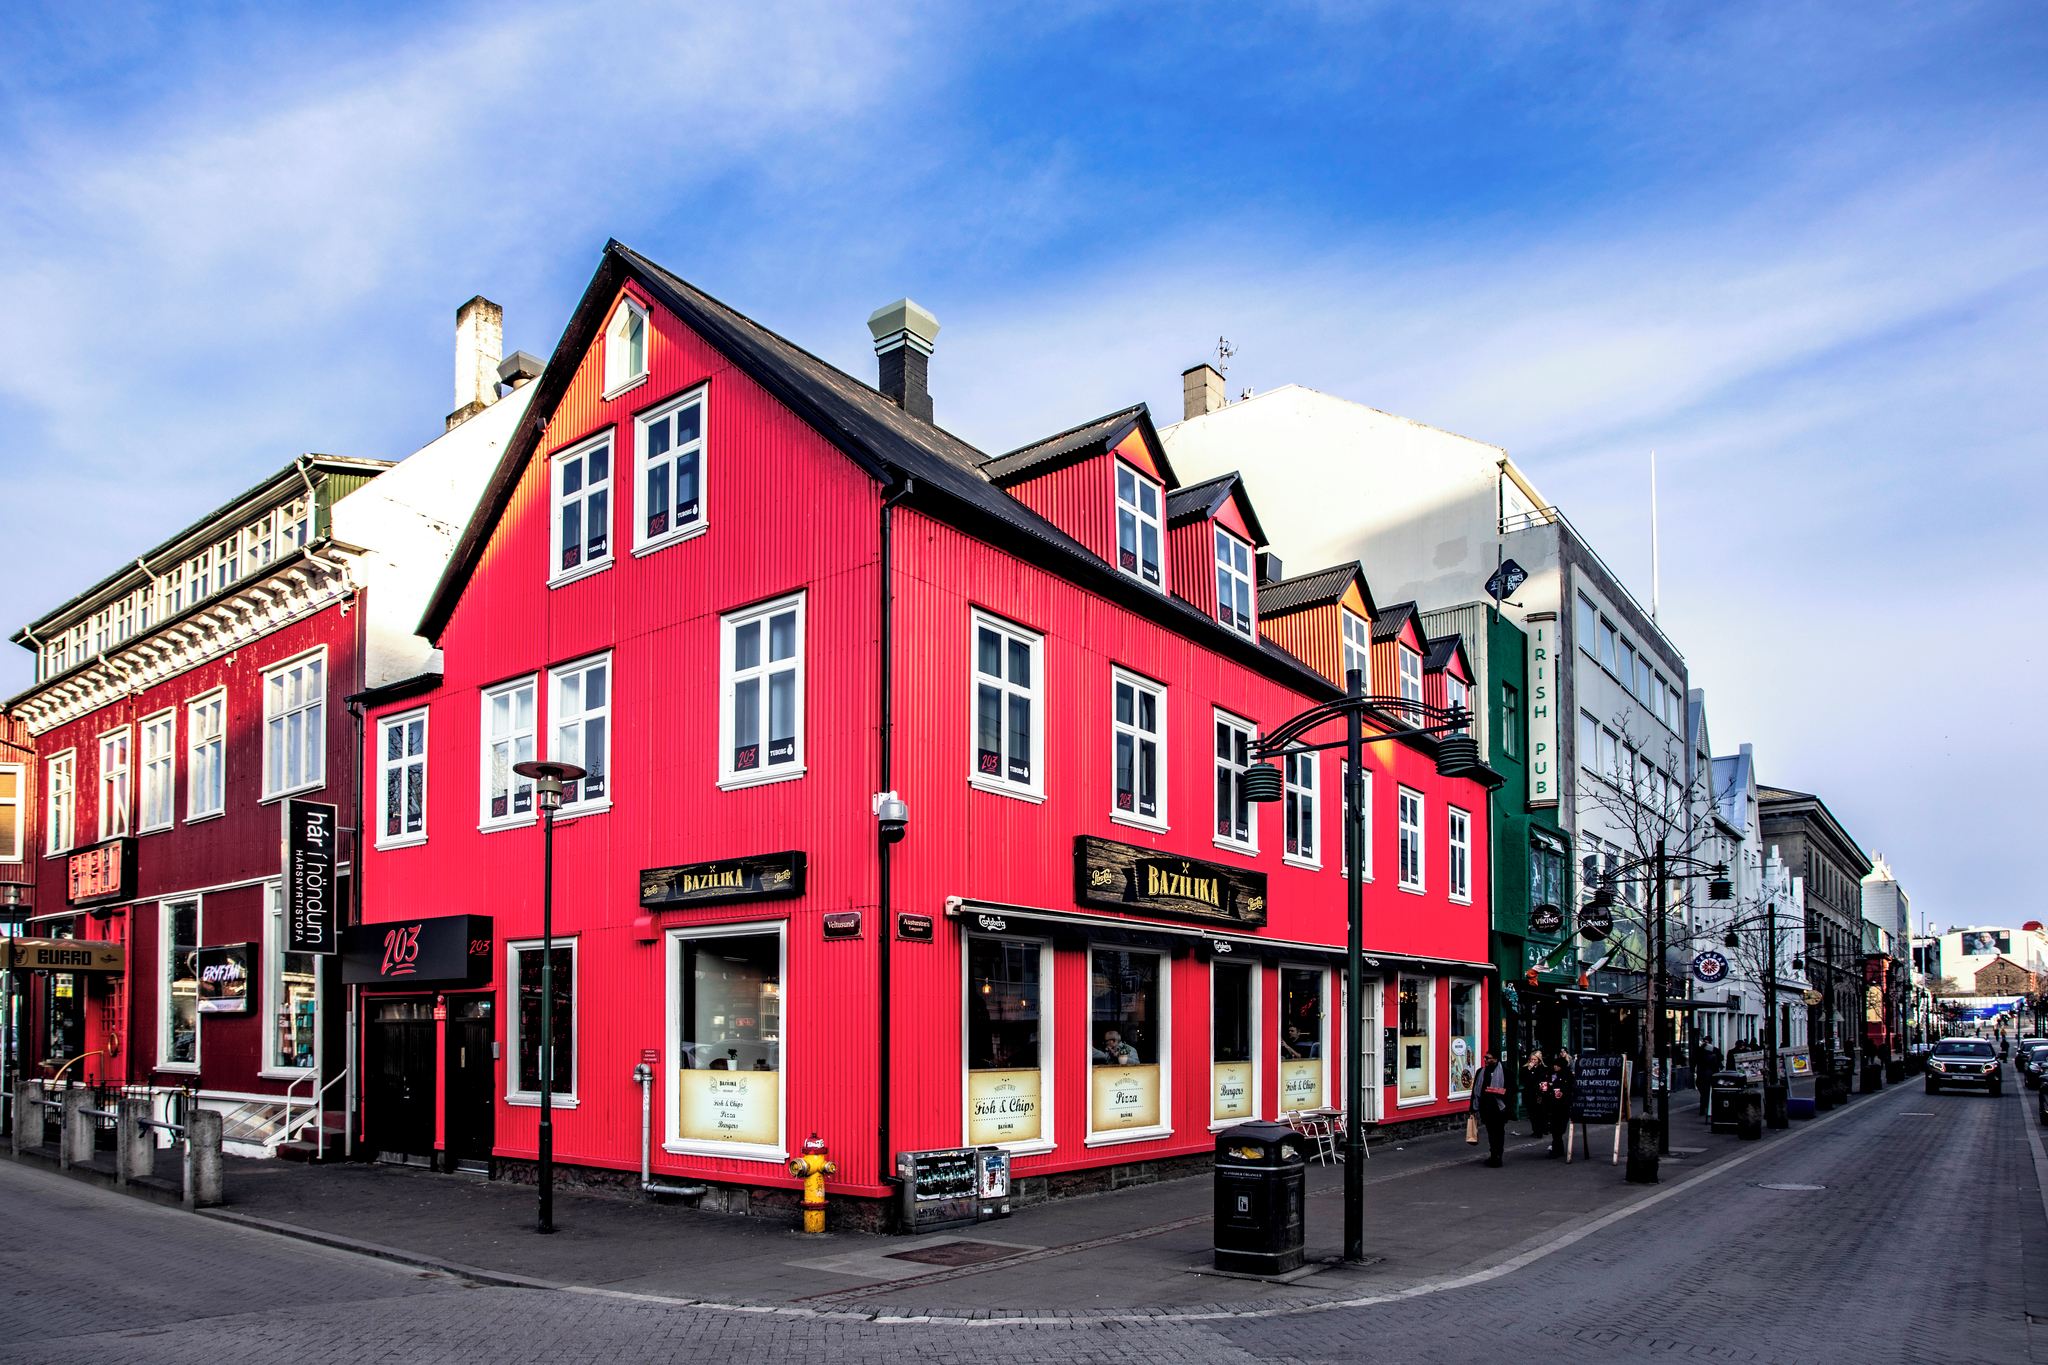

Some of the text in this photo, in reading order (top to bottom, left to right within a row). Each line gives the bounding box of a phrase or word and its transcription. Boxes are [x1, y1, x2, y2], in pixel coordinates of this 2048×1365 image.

[650, 514, 666, 534] 203
[564, 548, 578, 567] 203
[1535, 629, 1547, 794] IRISH PUB
[738, 748, 756, 768] 203
[769, 747, 787, 757] TUBORG
[982, 754, 998, 771] 203
[307, 812, 330, 847] hár
[683, 869, 744, 894] BAZILIKA
[1148, 864, 1220, 907] BAZILIKA
[295, 849, 305, 942] HÁRSNYRTISTOFA
[306, 862, 328, 944] höndum
[978, 914, 1006, 931] Carlsberg
[381, 924, 421, 975] 203
[469, 940, 490, 955] 203
[37, 949, 92, 966] BURRO
[1581, 1068, 1611, 1077] AND TRY
[1220, 1084, 1244, 1099] Burgers
[1285, 1081, 1297, 1092] Fish
[1302, 1079, 1316, 1093] Chips
[1115, 1091, 1138, 1104] Pizza
[974, 1098, 1034, 1116] Fish & Chips
